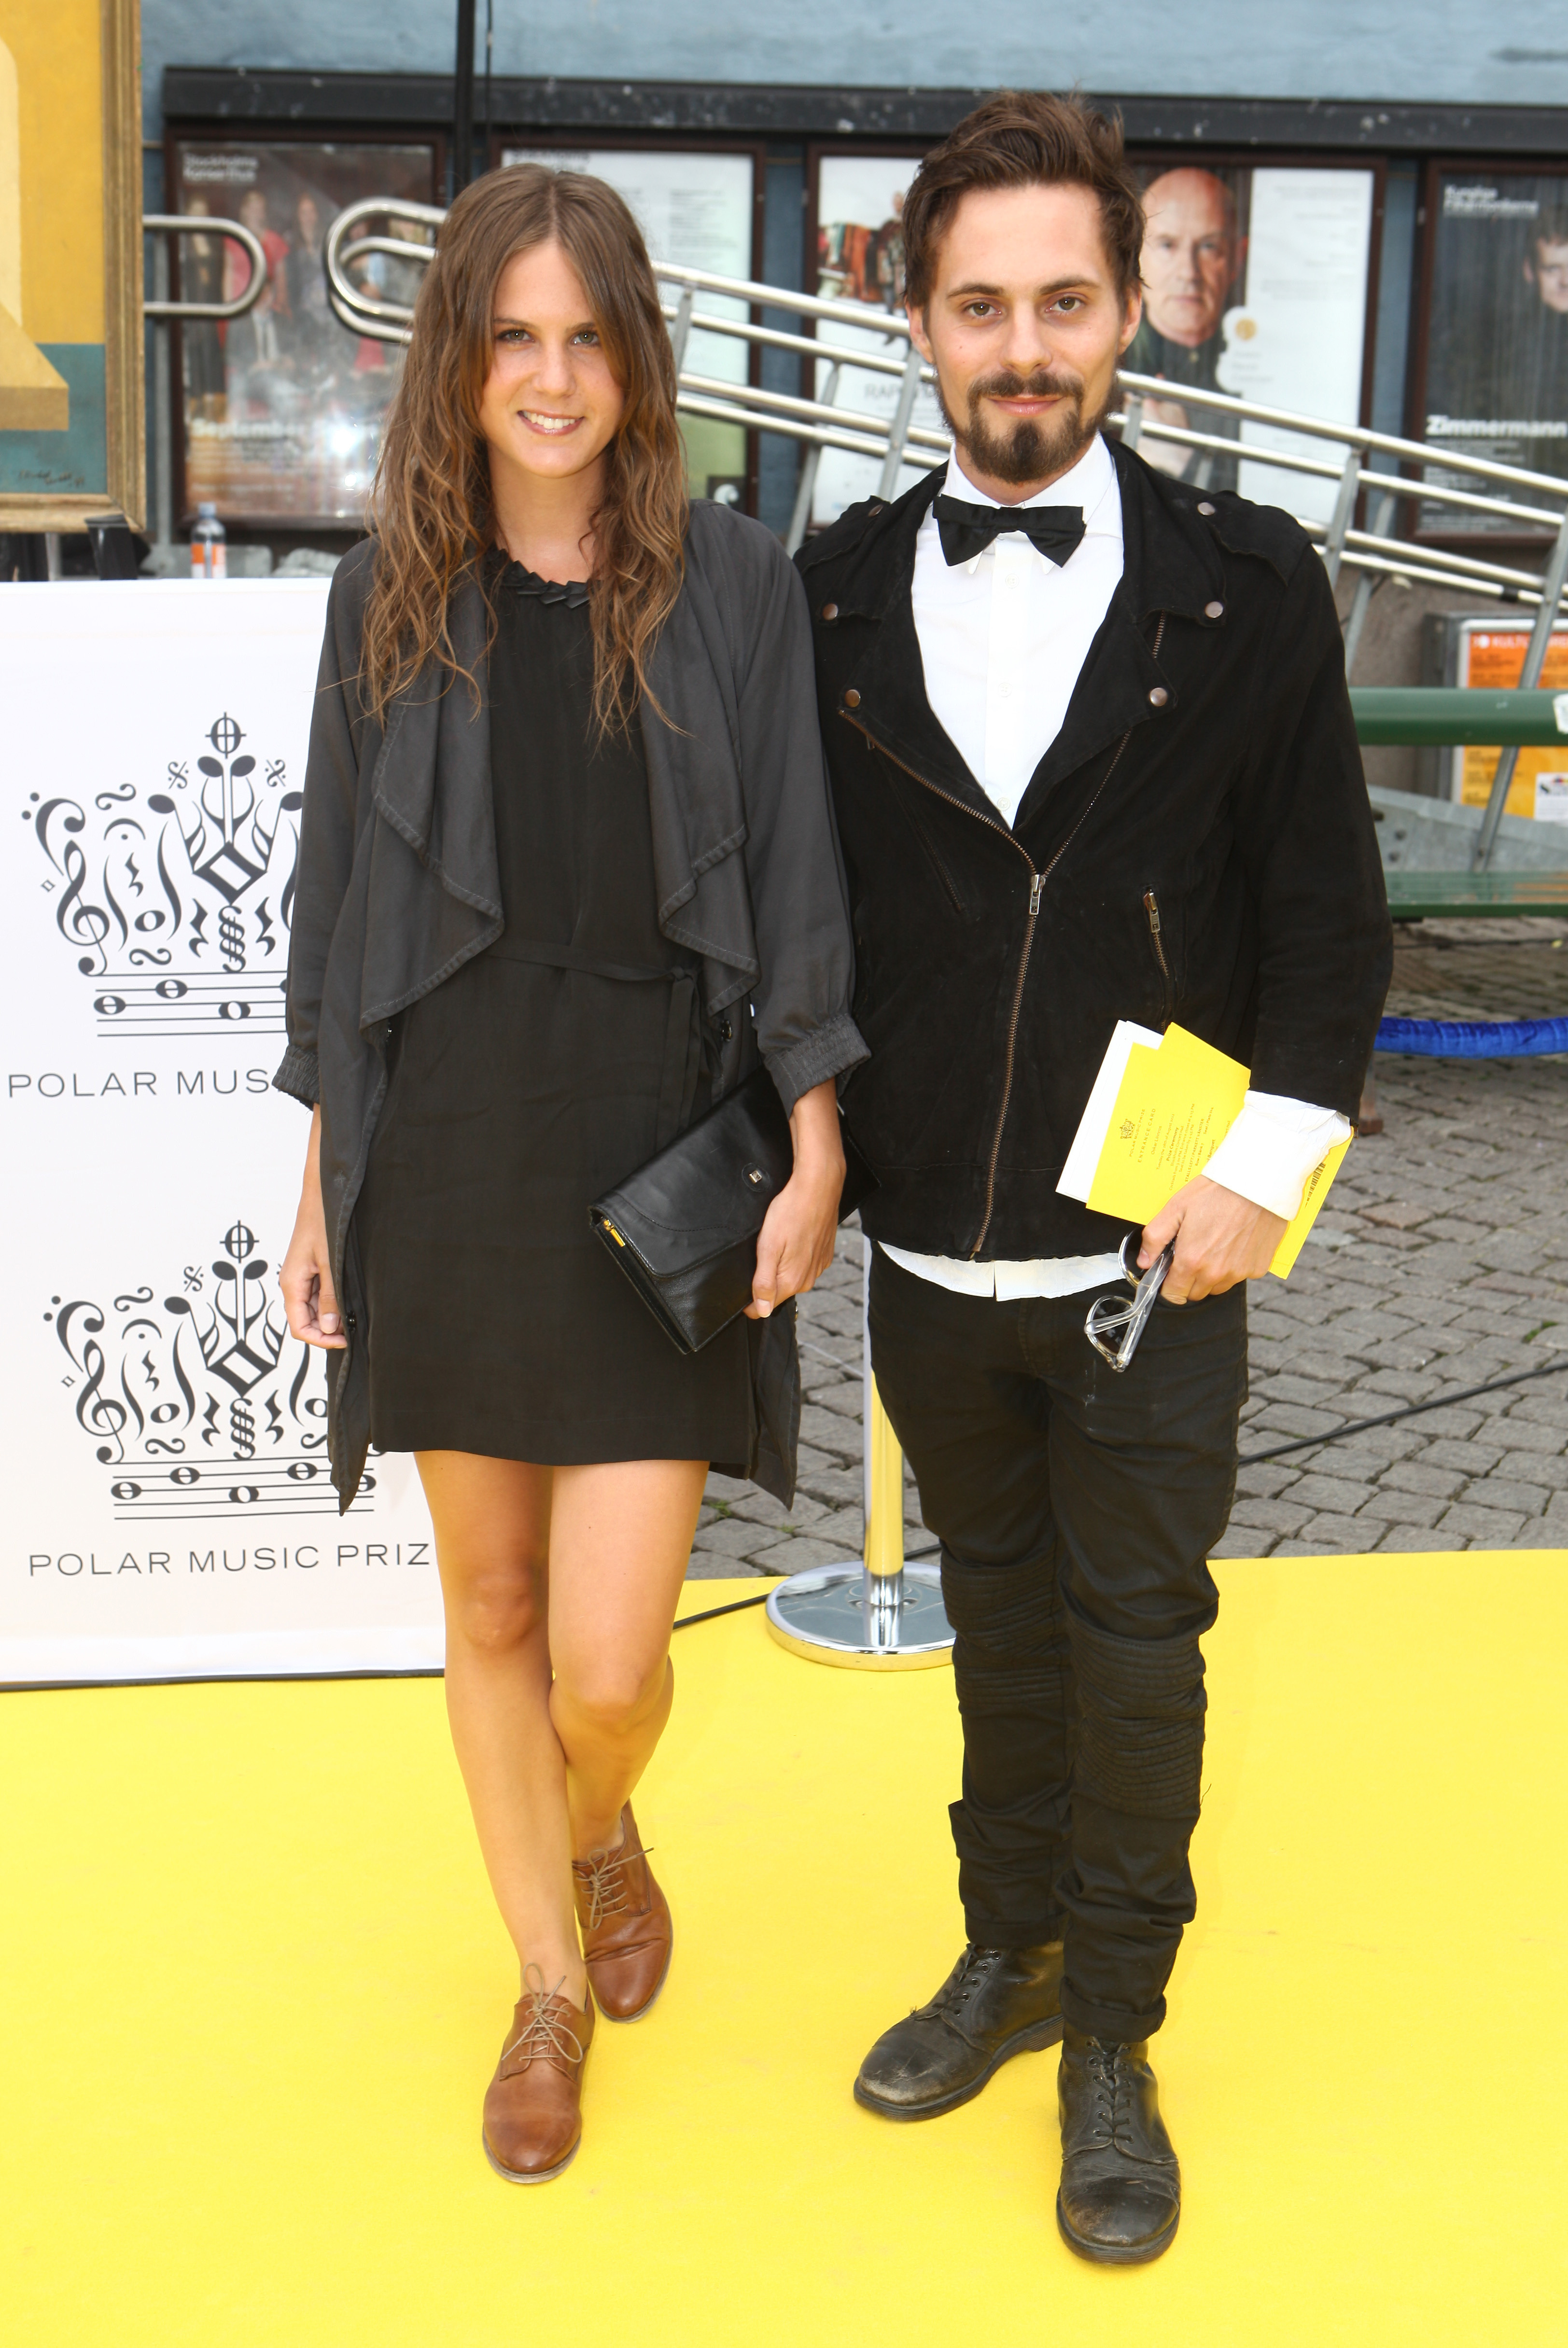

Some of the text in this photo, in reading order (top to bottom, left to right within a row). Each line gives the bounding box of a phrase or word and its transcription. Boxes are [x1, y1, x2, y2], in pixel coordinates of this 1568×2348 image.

[1427, 415, 1567, 437] Zimmermann
[9, 1069, 269, 1098] POLAR MUS
[1137, 1128, 1150, 1163] ENTRANCE
[1170, 1127, 1179, 1149] Ceremony
[29, 1543, 430, 1576] POLAR MUSIC PRIZ
